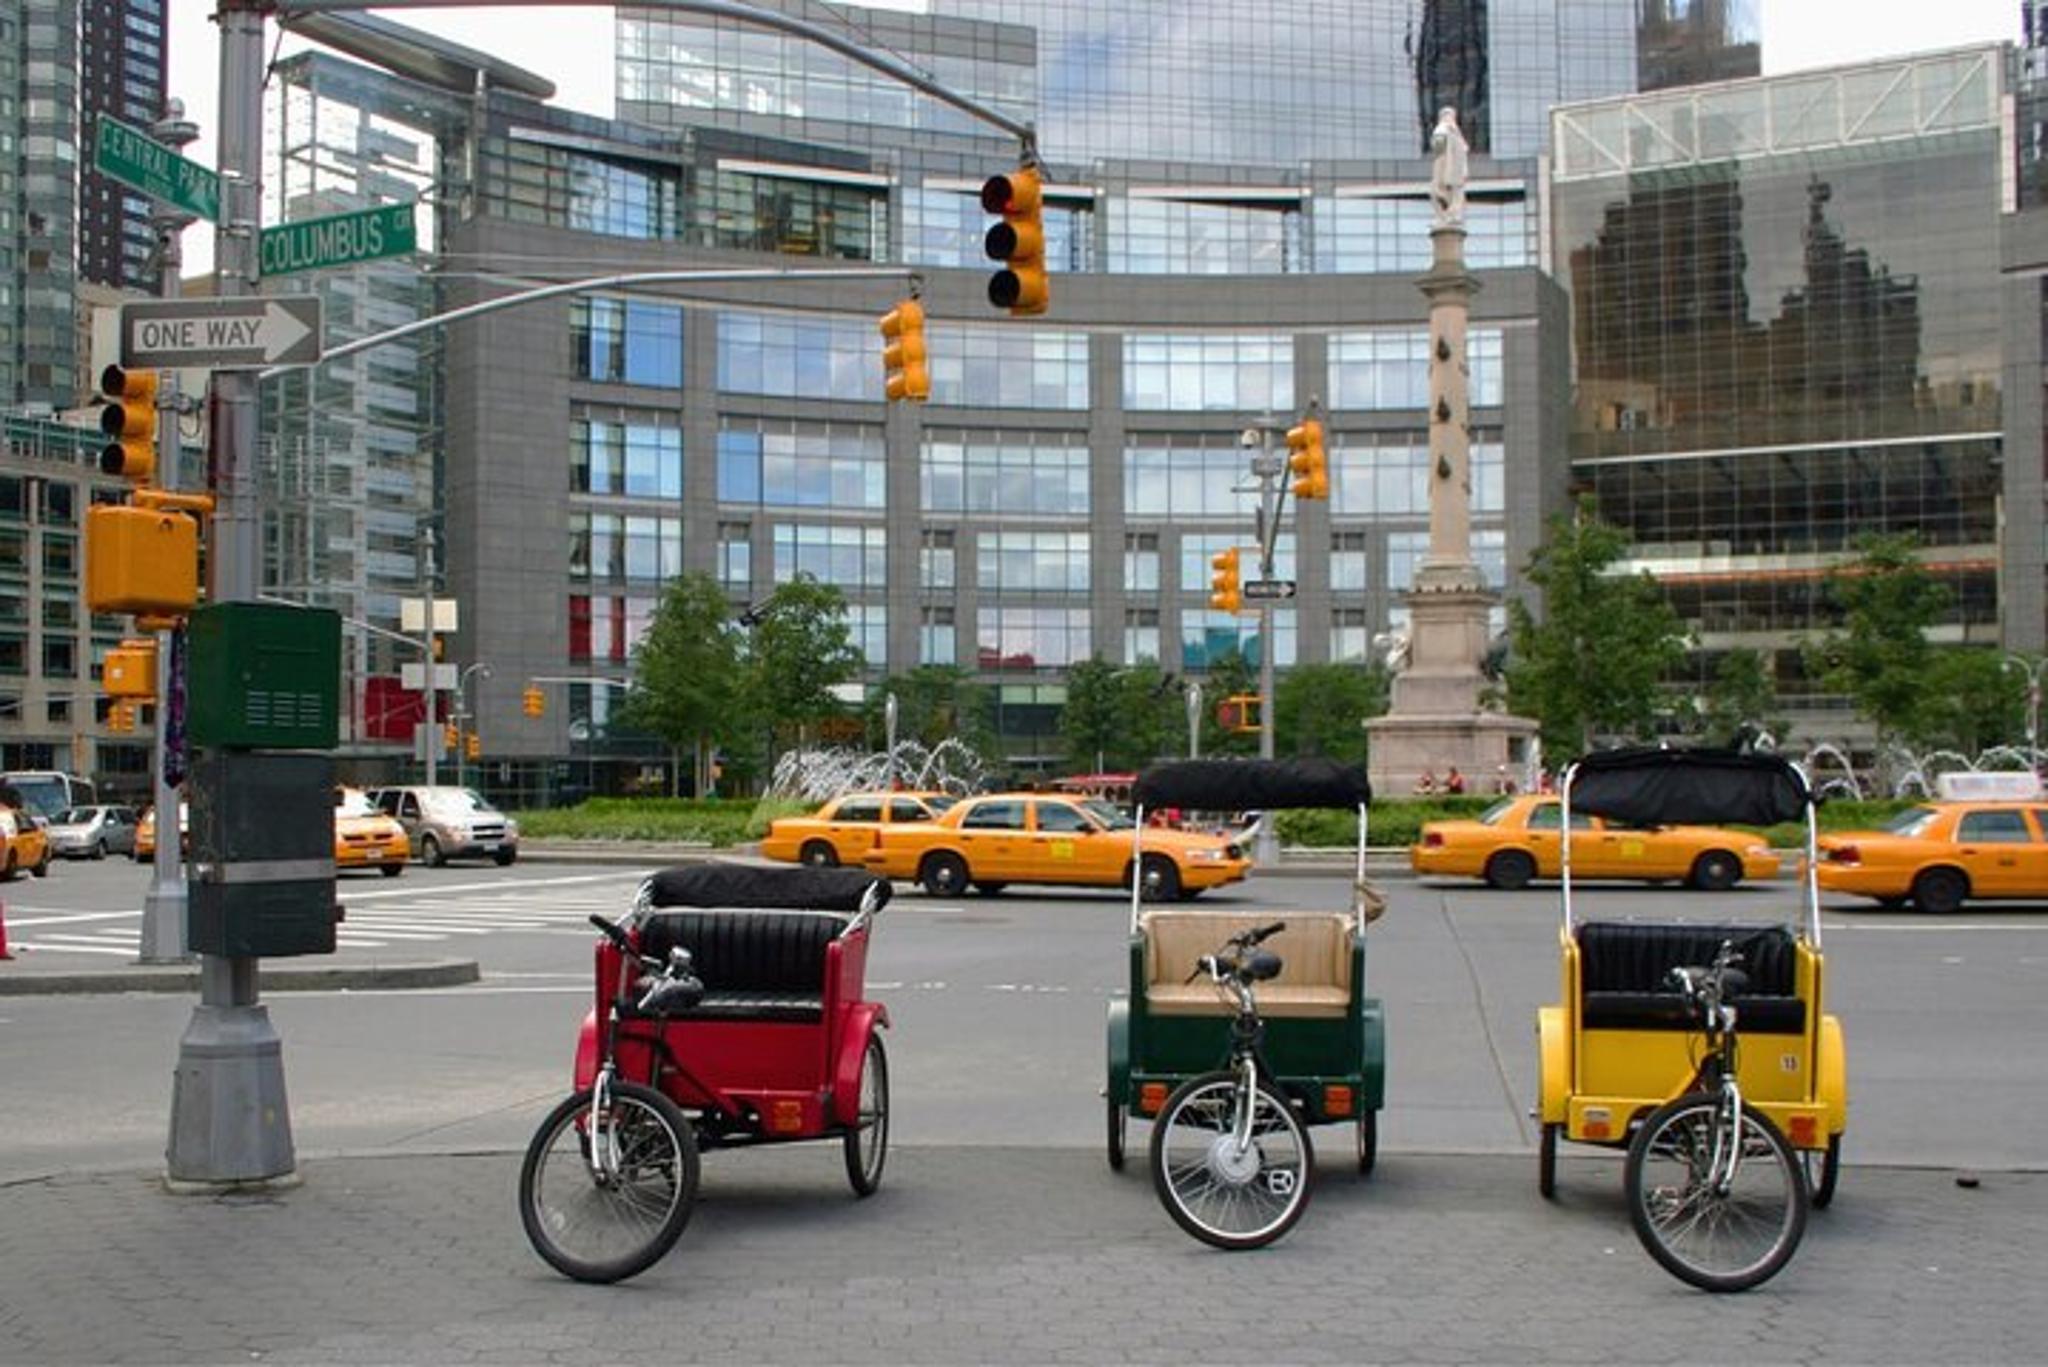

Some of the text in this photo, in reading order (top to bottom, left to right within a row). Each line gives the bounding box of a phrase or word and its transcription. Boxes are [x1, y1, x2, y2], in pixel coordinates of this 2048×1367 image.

[102, 121, 172, 181] CENTRAL
[261, 213, 383, 273] COLUMBUS
[141, 318, 263, 349] ONE WAY
